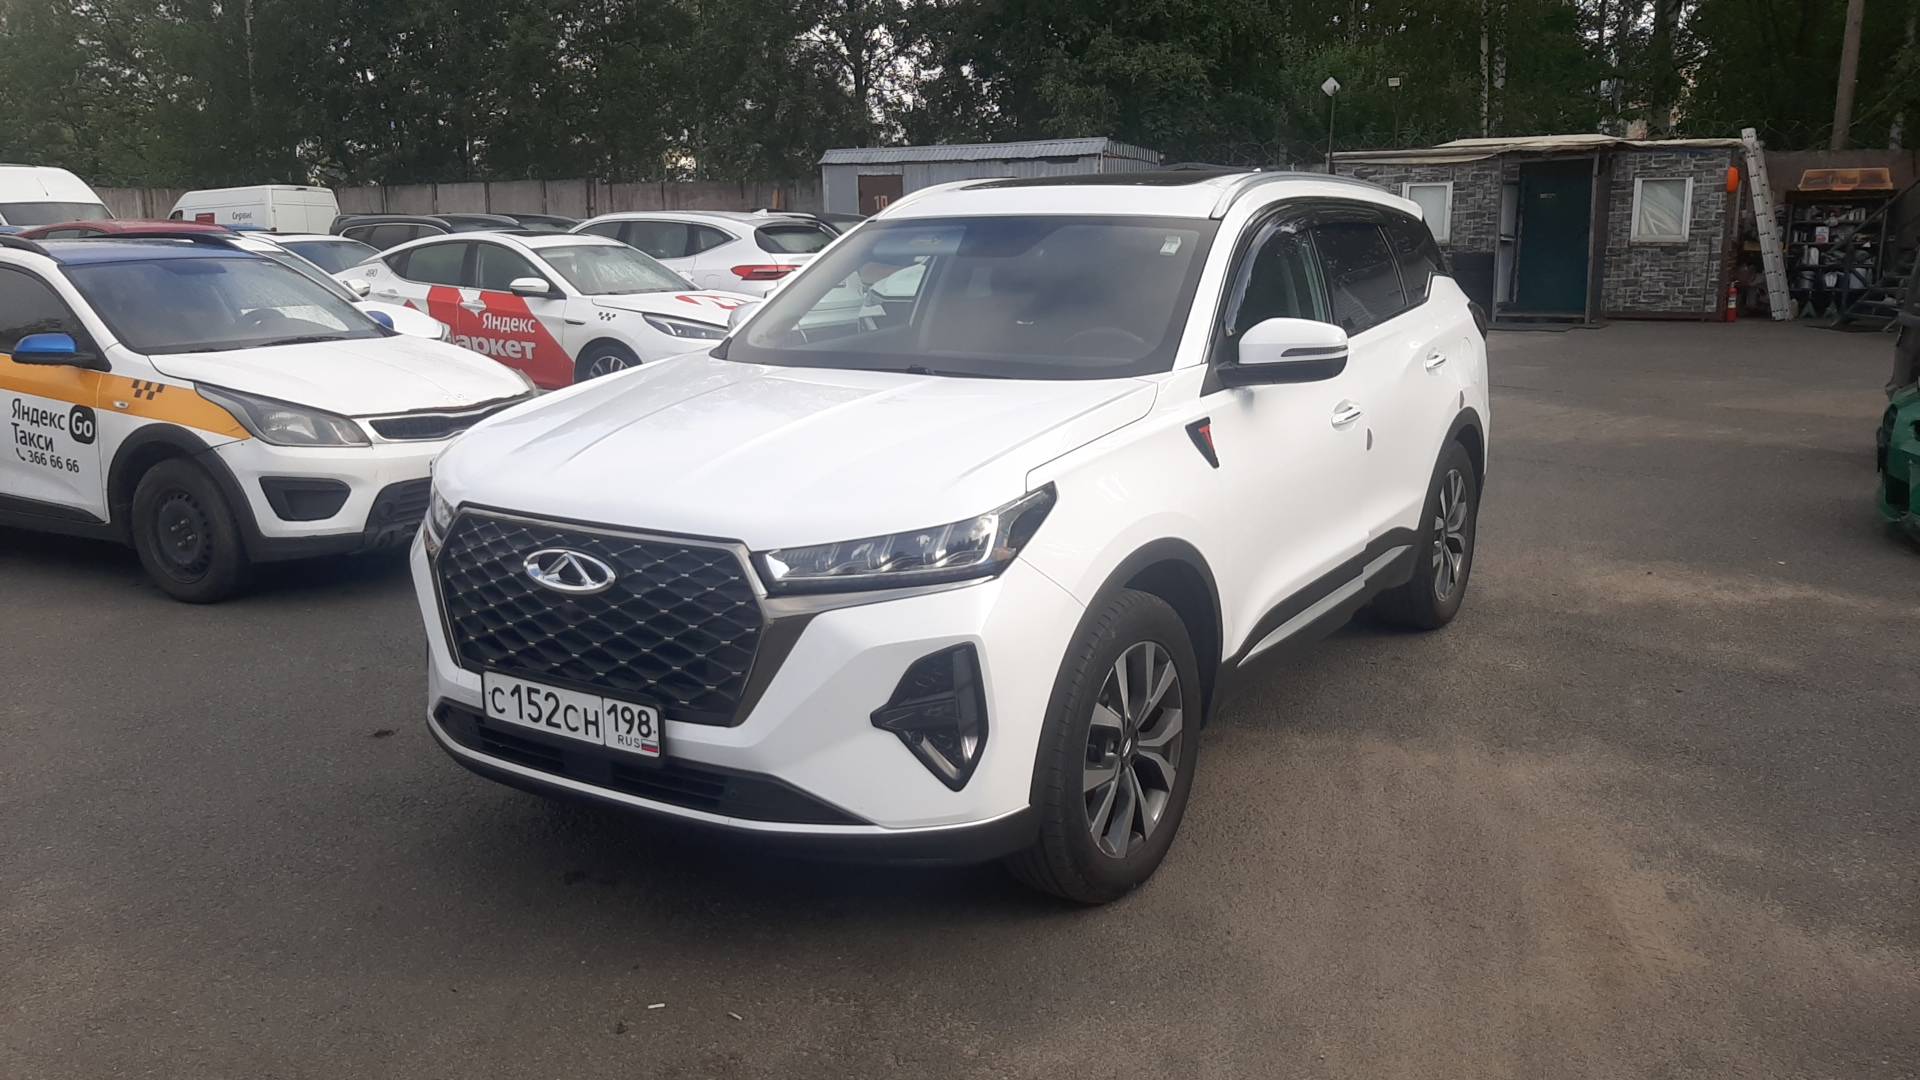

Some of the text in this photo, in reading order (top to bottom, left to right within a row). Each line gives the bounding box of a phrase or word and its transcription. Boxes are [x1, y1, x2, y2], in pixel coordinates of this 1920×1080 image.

[482, 312, 536, 334] Яндекс
[451, 334, 536, 360] аркет
[11, 398, 94, 438] Яндекс Go
[11, 422, 54, 453] Такси
[27, 450, 80, 474] 366 66 66
[606, 703, 652, 739] 198
[617, 734, 641, 749] RUS
